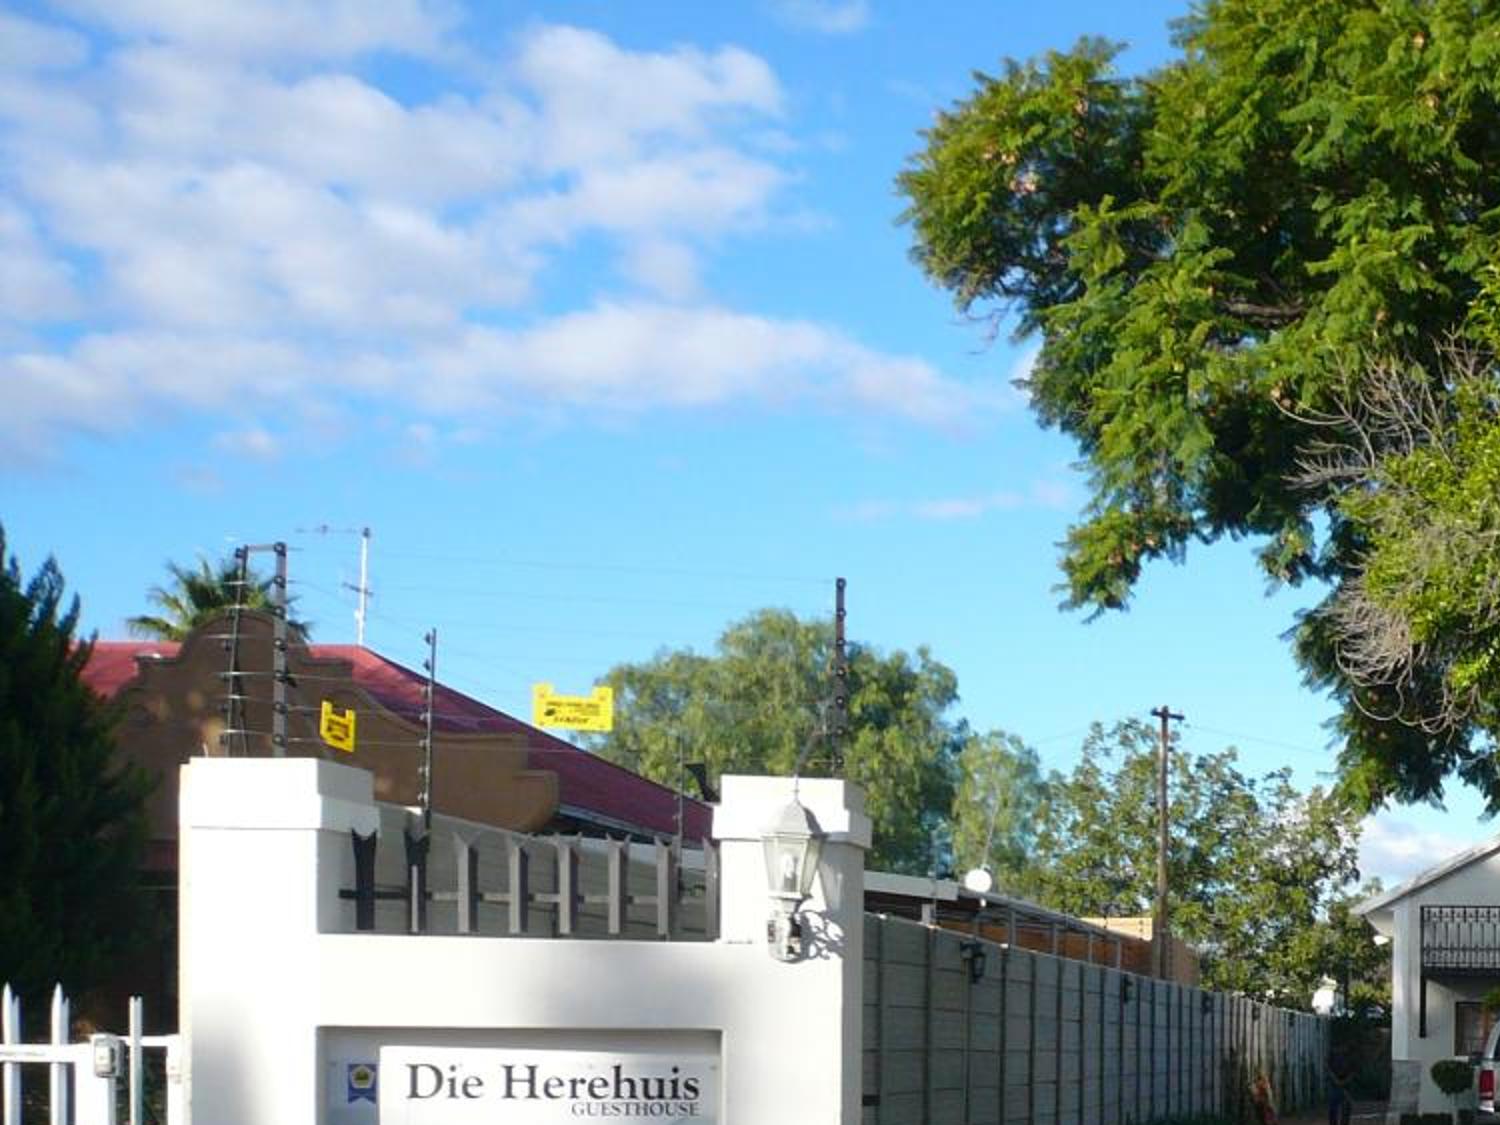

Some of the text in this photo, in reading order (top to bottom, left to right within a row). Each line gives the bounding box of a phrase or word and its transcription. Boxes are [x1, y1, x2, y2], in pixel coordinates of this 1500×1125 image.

[406, 1062, 701, 1101] Die Herehuis
[571, 1101, 701, 1118] GUESTHOUSE
